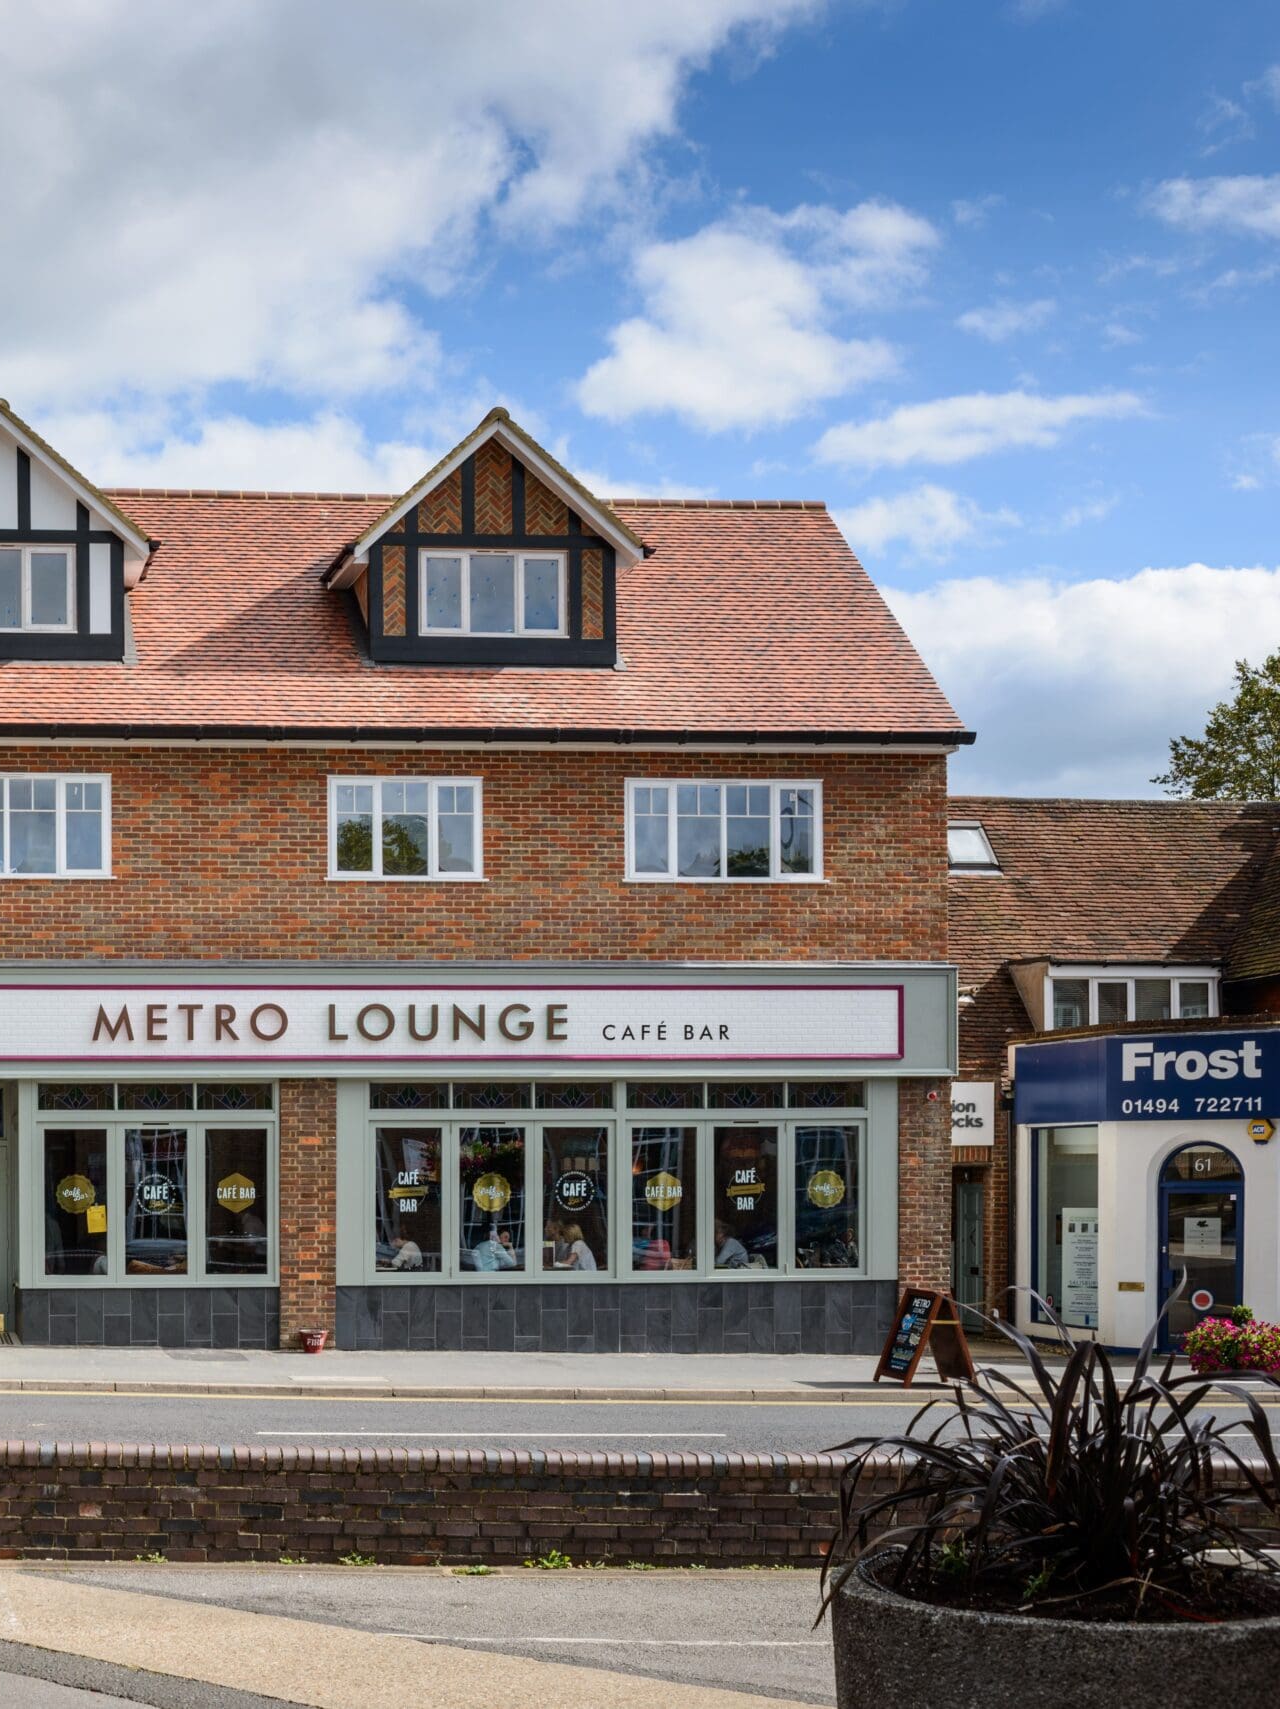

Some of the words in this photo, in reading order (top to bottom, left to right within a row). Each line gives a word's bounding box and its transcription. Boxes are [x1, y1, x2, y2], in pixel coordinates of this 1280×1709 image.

[92, 1003, 289, 1041] METRO
[328, 1003, 568, 1041] LOUNGE
[602, 1020, 667, 1040] CAFÉ
[683, 1024, 730, 1040] BAR
[1122, 1040, 1262, 1082] Frost
[1121, 1098, 1180, 1114] 01494
[1194, 1096, 1262, 1112] 722711
[1194, 1158, 1211, 1172] 61
[398, 1168, 419, 1185] CAFÉ
[735, 1167, 756, 1183] CAFÉ
[143, 1182, 168, 1200] CAFÉ
[216, 1184, 237, 1199] CAFÉ
[239, 1187, 256, 1199] BAR
[563, 1179, 587, 1197] CAFÉ
[645, 1183, 665, 1197] CAFÉ
[667, 1186, 683, 1198] BAR
[400, 1198, 417, 1212] BAR
[737, 1196, 754, 1211] BAR
[912, 1297, 931, 1309] METRO
